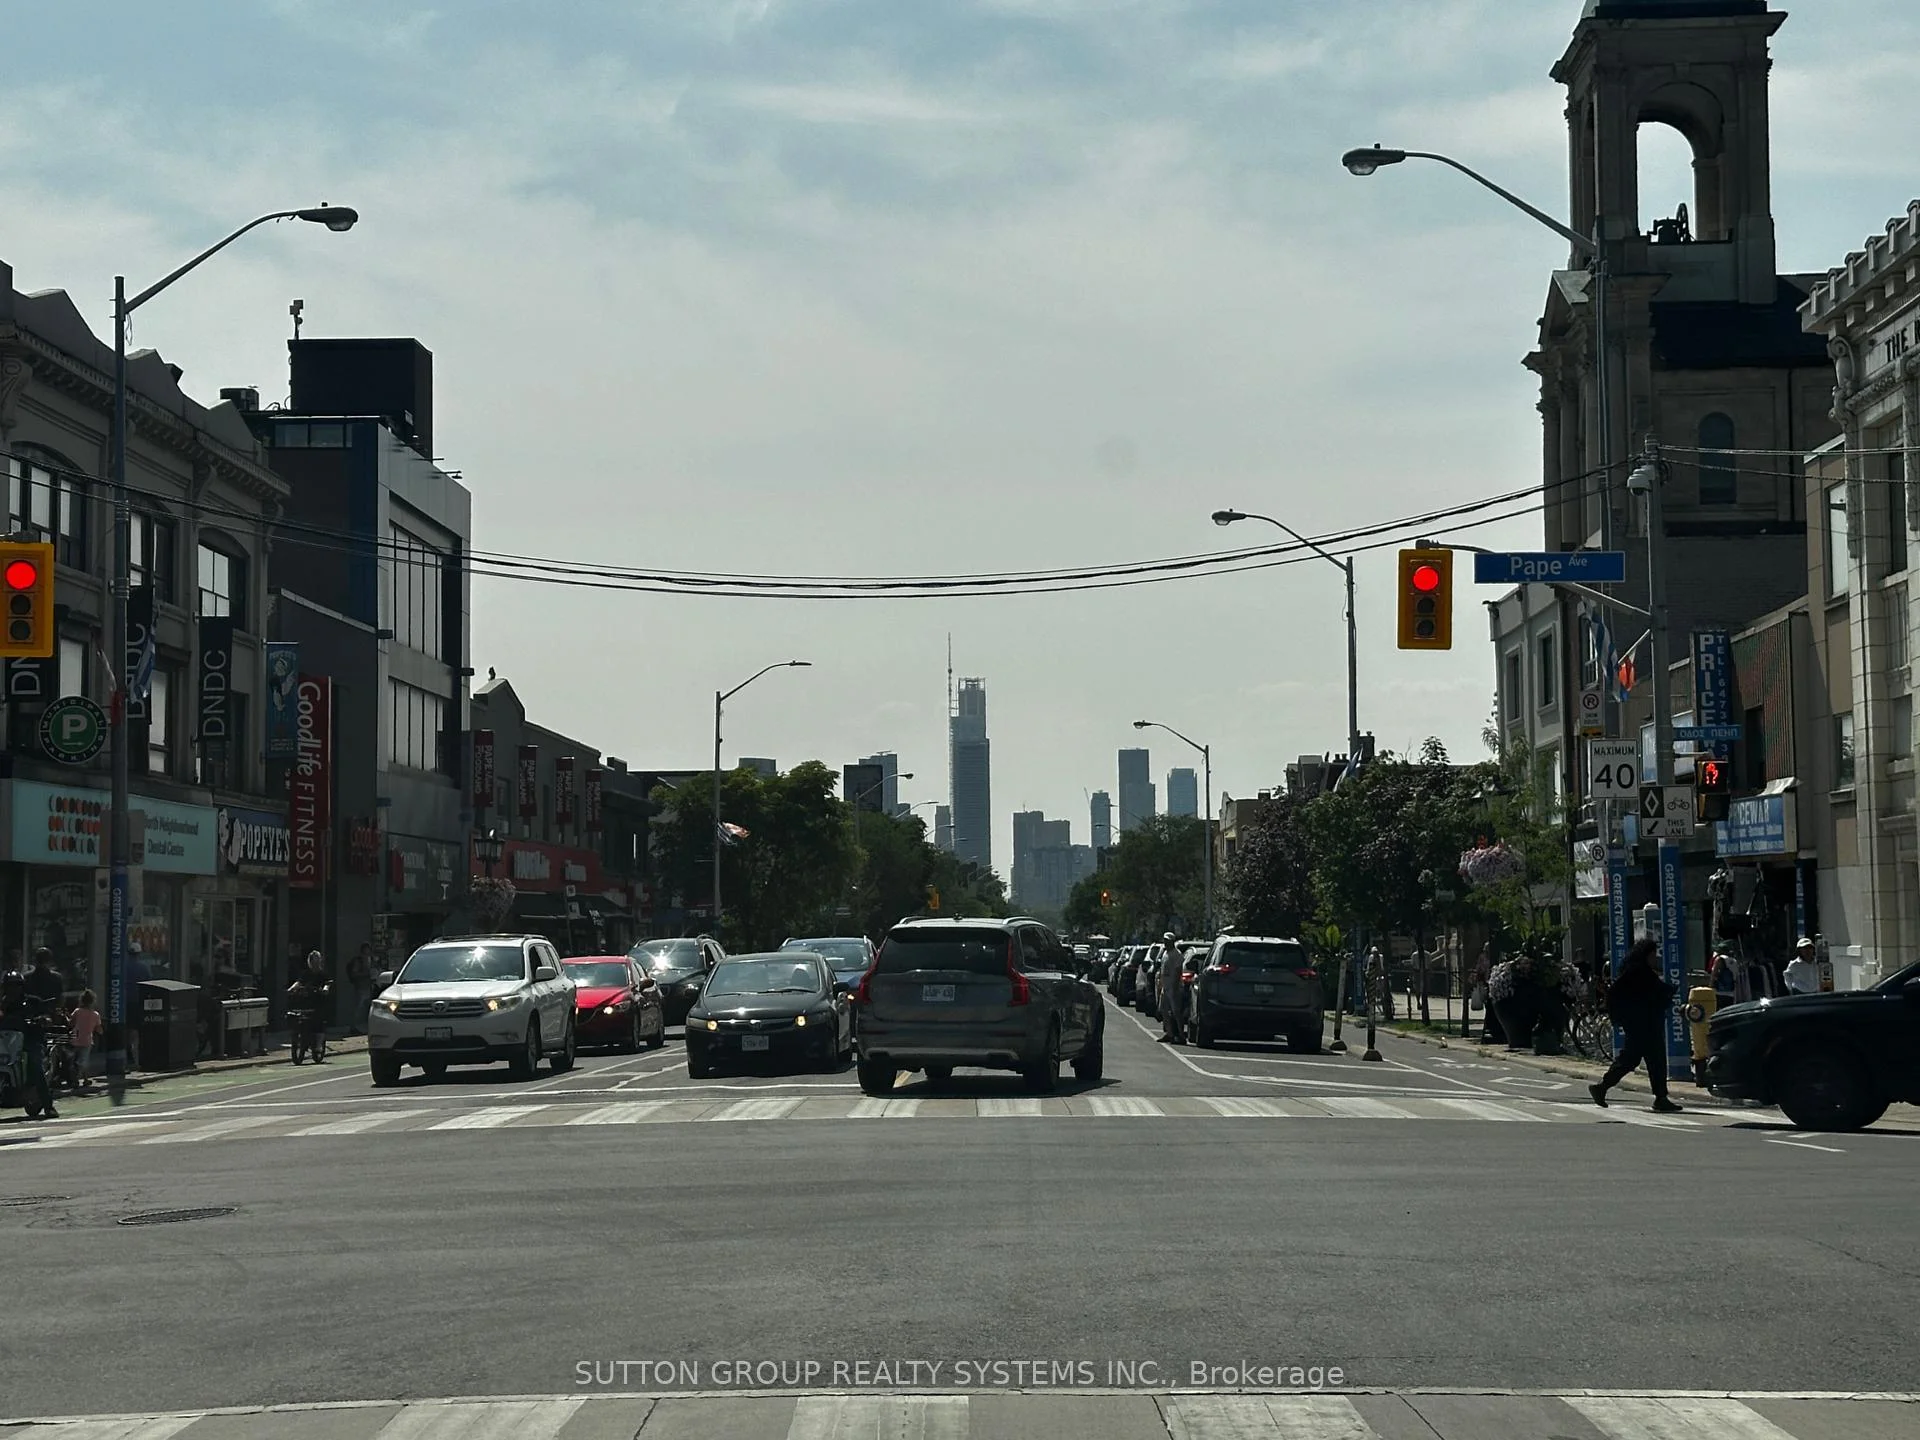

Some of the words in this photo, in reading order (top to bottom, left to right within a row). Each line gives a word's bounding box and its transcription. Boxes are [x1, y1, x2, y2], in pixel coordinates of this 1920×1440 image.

[1885, 328, 1908, 362] THE
[1510, 556, 1562, 580] Pape
[1568, 556, 1588, 567] Ave
[203, 650, 226, 736] DNDC
[62, 714, 88, 740] P
[297, 680, 322, 777] GoodLife
[1594, 746, 1635, 756] MAXIMUM
[1594, 763, 1635, 789] 40
[240, 823, 291, 863] POPEYE'S
[295, 781, 315, 876] FITNESS
[1665, 827, 1686, 835] LANE
[112, 887, 122, 955] GREEKTOWN
[1612, 873, 1625, 946] GREEKTOWN
[1665, 863, 1678, 939] GREEKTOWN
